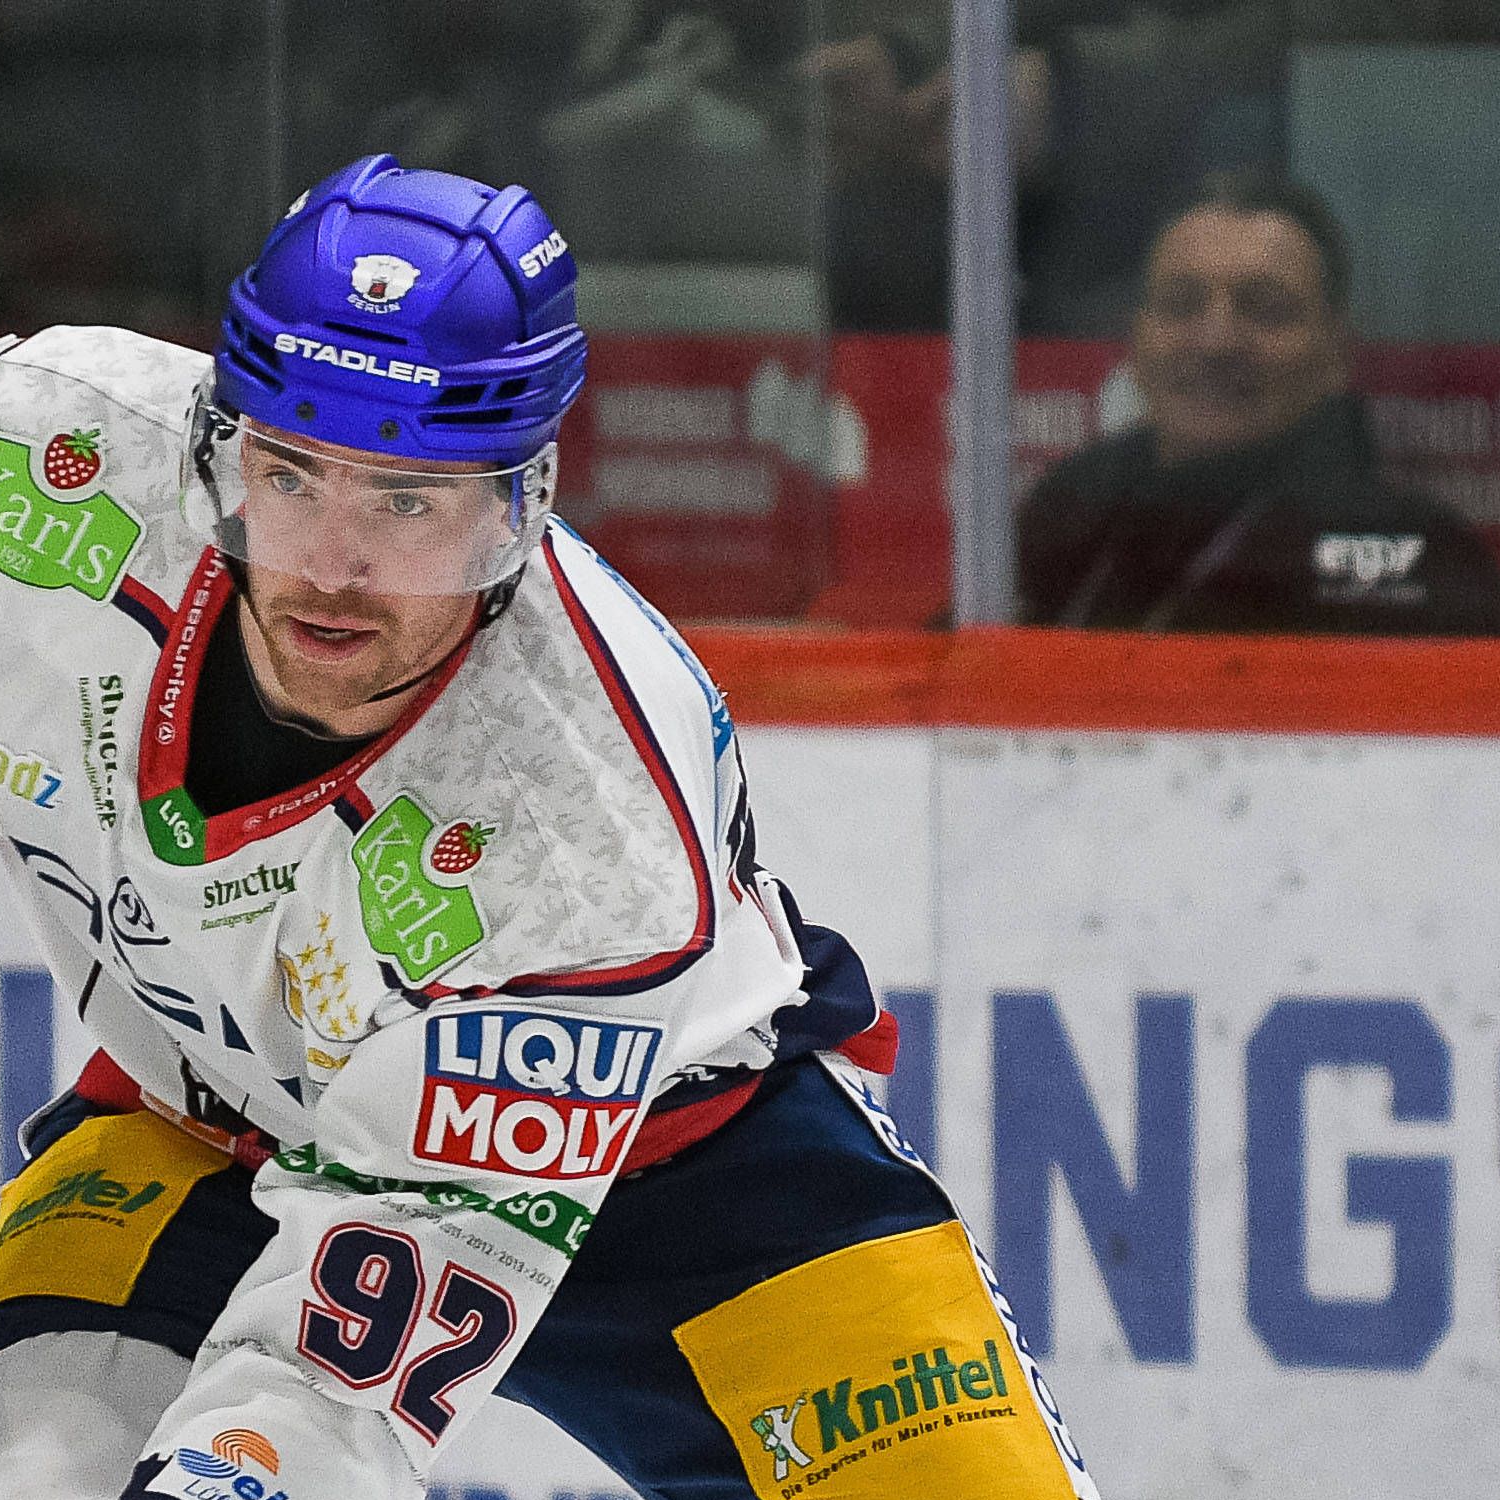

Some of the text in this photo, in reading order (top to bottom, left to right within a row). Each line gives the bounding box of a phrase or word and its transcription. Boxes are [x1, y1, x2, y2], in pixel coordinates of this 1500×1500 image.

[518, 229, 569, 278] STAD
[346, 294, 402, 315] BERLIN
[274, 333, 441, 388] STADLER
[158, 799, 195, 850] LIGO
[359, 814, 451, 967] Karls
[437, 1015, 656, 1098] LIQUI
[423, 1086, 638, 1175] MOLY
[297, 1221, 518, 1448] 92
[811, 1338, 1009, 1455] Knittel
[781, 1477, 804, 1500] Die
[806, 1448, 868, 1487] Experten
[871, 1435, 894, 1454] für
[897, 1417, 940, 1443] Maler
[943, 1414, 954, 1428] &
